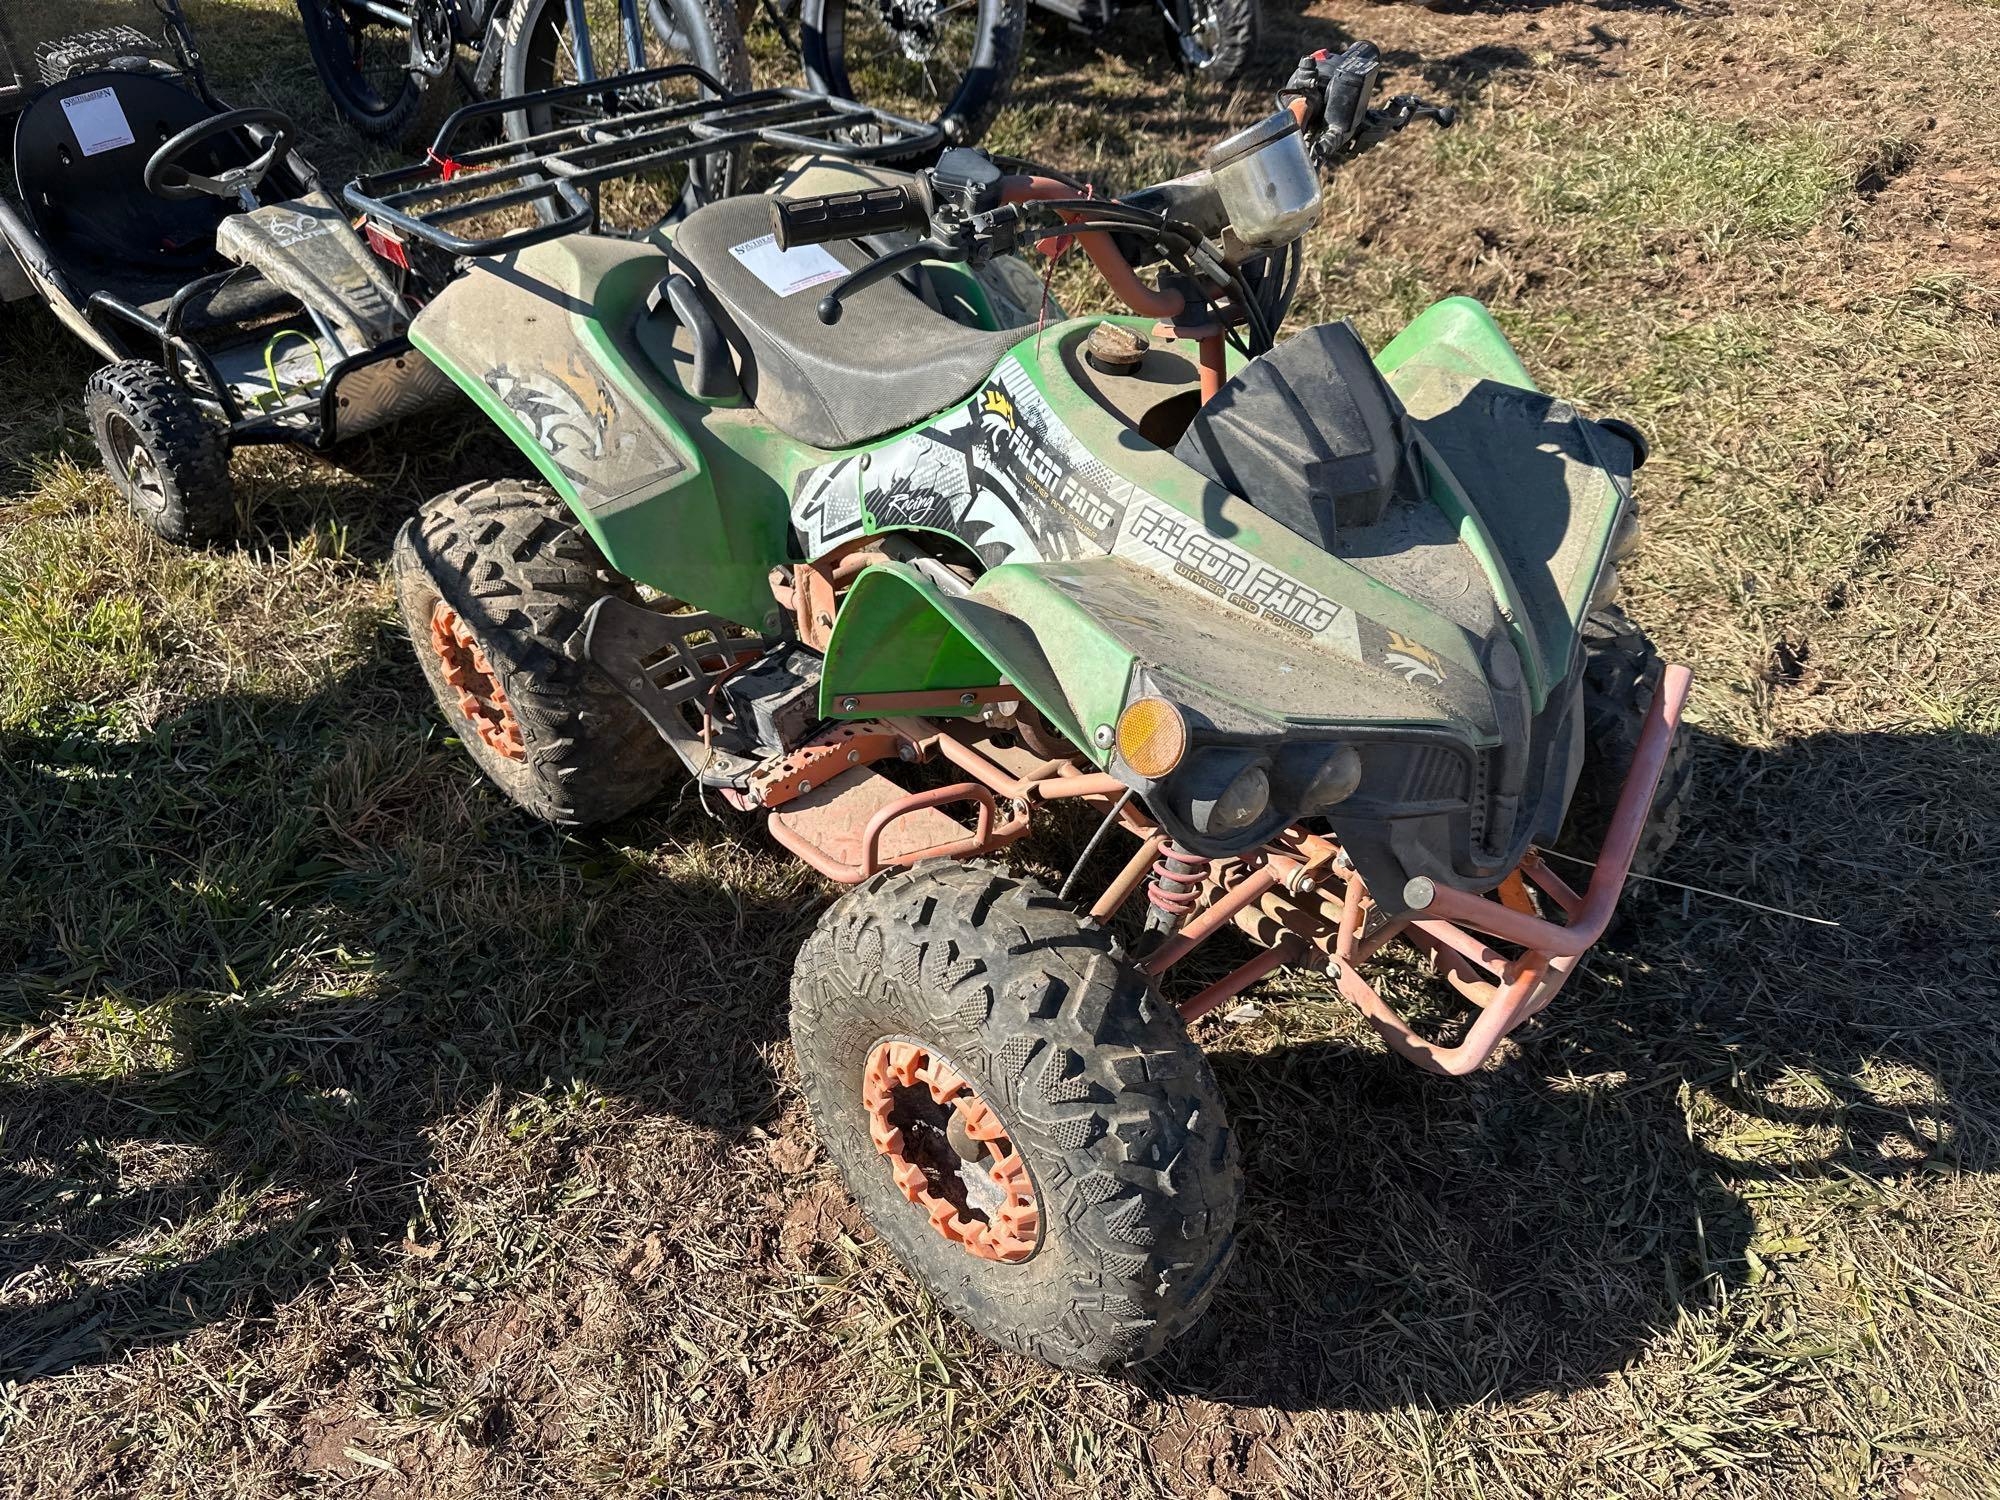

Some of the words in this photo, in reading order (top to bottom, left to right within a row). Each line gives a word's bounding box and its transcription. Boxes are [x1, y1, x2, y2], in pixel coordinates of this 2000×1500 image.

[885, 494, 935, 523] Racing
[1009, 426, 1063, 492] FALCON
[1060, 477, 1116, 530] FANG
[1025, 473, 1049, 500] WINNER
[1050, 499, 1066, 515] AND
[1068, 513, 1098, 539] POWER
[1129, 504, 1250, 591] FALCON
[1243, 567, 1343, 633] FANG
[1173, 560, 1227, 599] WINNER
[1227, 592, 1260, 615] AND
[1260, 611, 1314, 639] POWER
